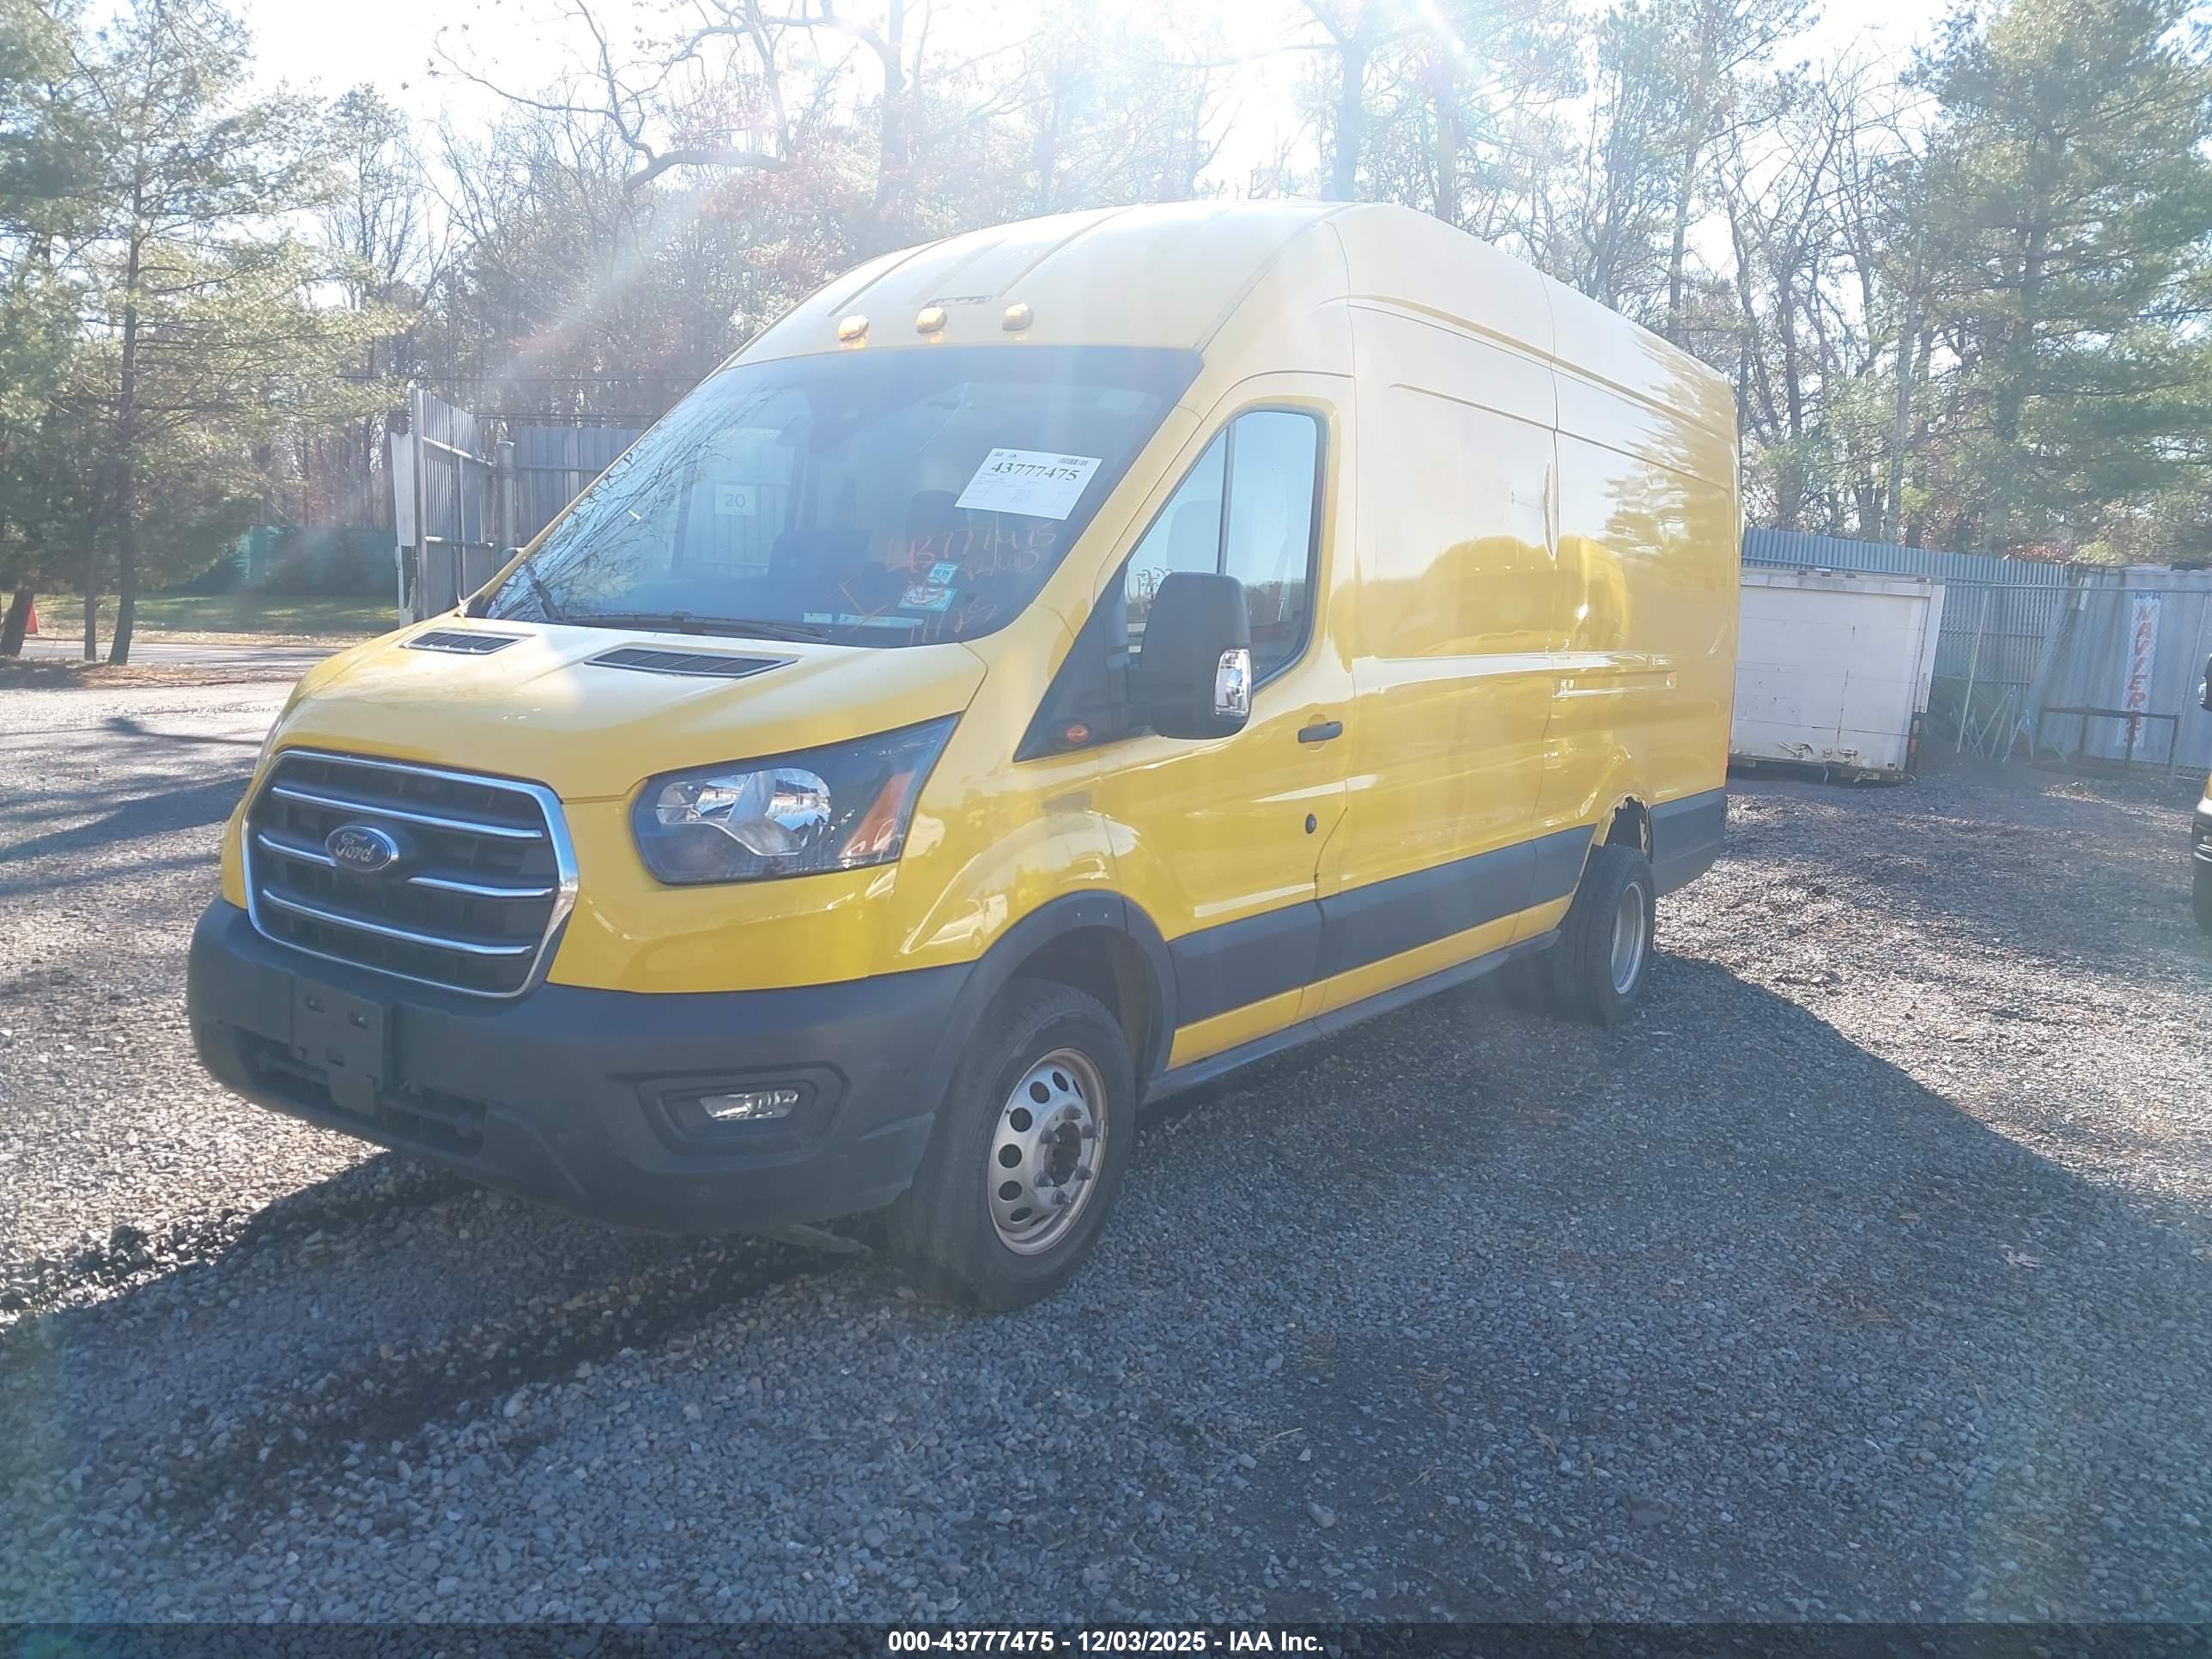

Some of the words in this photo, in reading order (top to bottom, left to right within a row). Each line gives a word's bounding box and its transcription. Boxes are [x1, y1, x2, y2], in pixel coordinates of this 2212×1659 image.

[991, 461, 1080, 482] 43777475
[725, 493, 746, 509] 20
[2134, 591, 2161, 600] NPR
[335, 832, 377, 863] Ford
